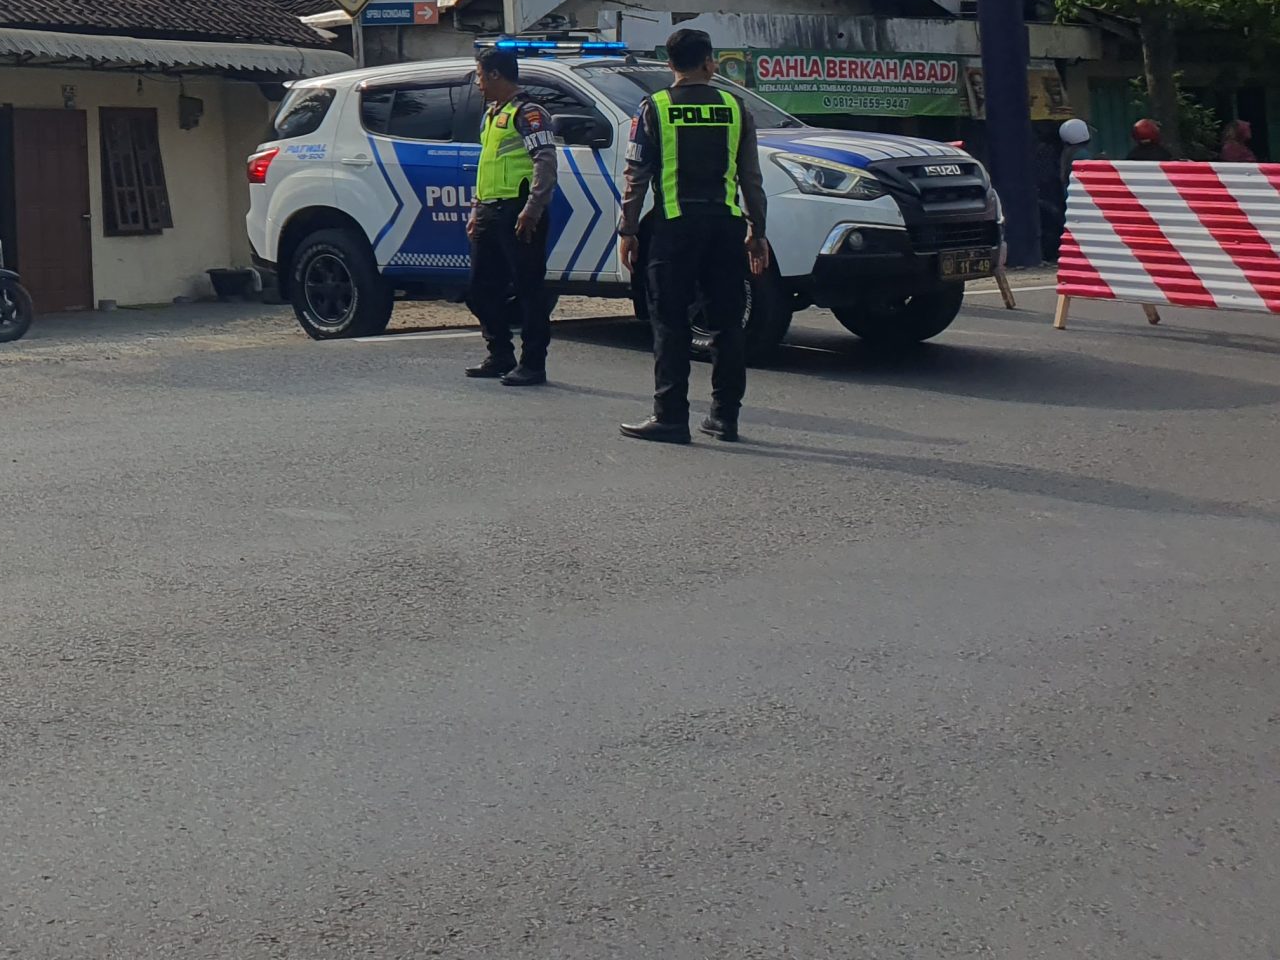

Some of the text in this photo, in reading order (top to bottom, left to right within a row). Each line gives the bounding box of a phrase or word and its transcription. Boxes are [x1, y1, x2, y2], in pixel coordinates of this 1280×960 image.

[758, 56, 956, 83] SAHLA BERKAH ABADI
[759, 84, 792, 92] MENJUAL
[794, 84, 818, 92] ANEKA
[820, 84, 852, 93] SEMBAKO
[852, 85, 867, 93] DAN
[868, 85, 907, 94] KEBUTUHAN
[908, 86, 932, 95] RUMAH
[668, 106, 734, 125] POLISI
[924, 164, 961, 176] ISUZU
[432, 212, 458, 222] LALU
